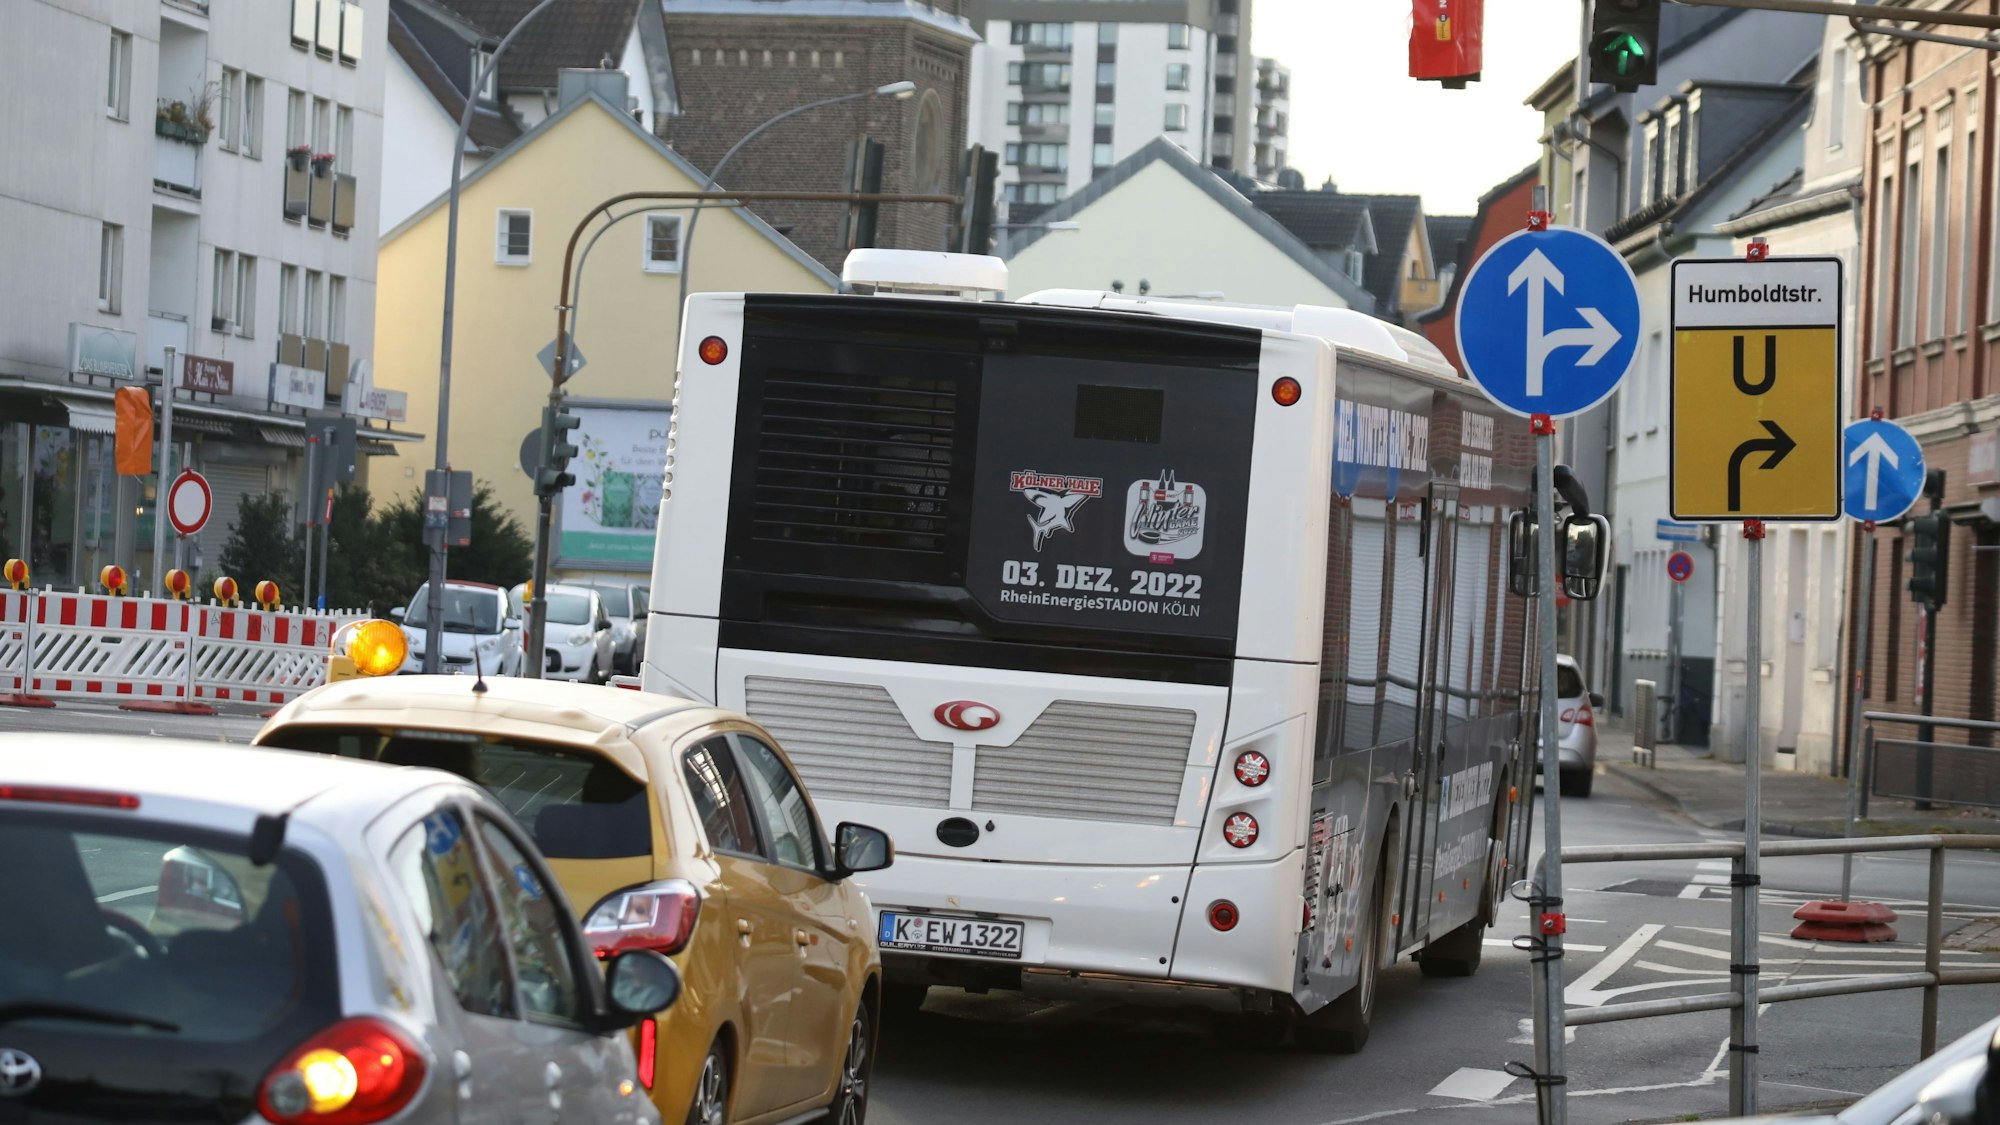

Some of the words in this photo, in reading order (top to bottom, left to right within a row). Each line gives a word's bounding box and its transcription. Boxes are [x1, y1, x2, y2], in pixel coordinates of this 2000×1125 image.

[1688, 284, 1822, 303] Humboldtstr.
[1733, 335, 1777, 396] U
[1357, 403, 1388, 466] WINTER
[1389, 410, 1411, 469] GAME
[1411, 414, 1428, 472] 2022
[1013, 472, 1064, 489] KÖLNER
[1068, 479, 1100, 495] HAIE
[1130, 499, 1200, 540] Winter
[1169, 517, 1198, 530] GAME
[1002, 559, 1045, 587] 03.
[1055, 564, 1119, 593] DEZ.
[1130, 569, 1202, 599] 2022
[1000, 589, 1159, 614] RheinEnergieSTADION
[1162, 600, 1200, 617] KÖLN
[895, 918, 911, 940] K
[926, 920, 956, 944] EW
[960, 923, 1018, 949] 1322
